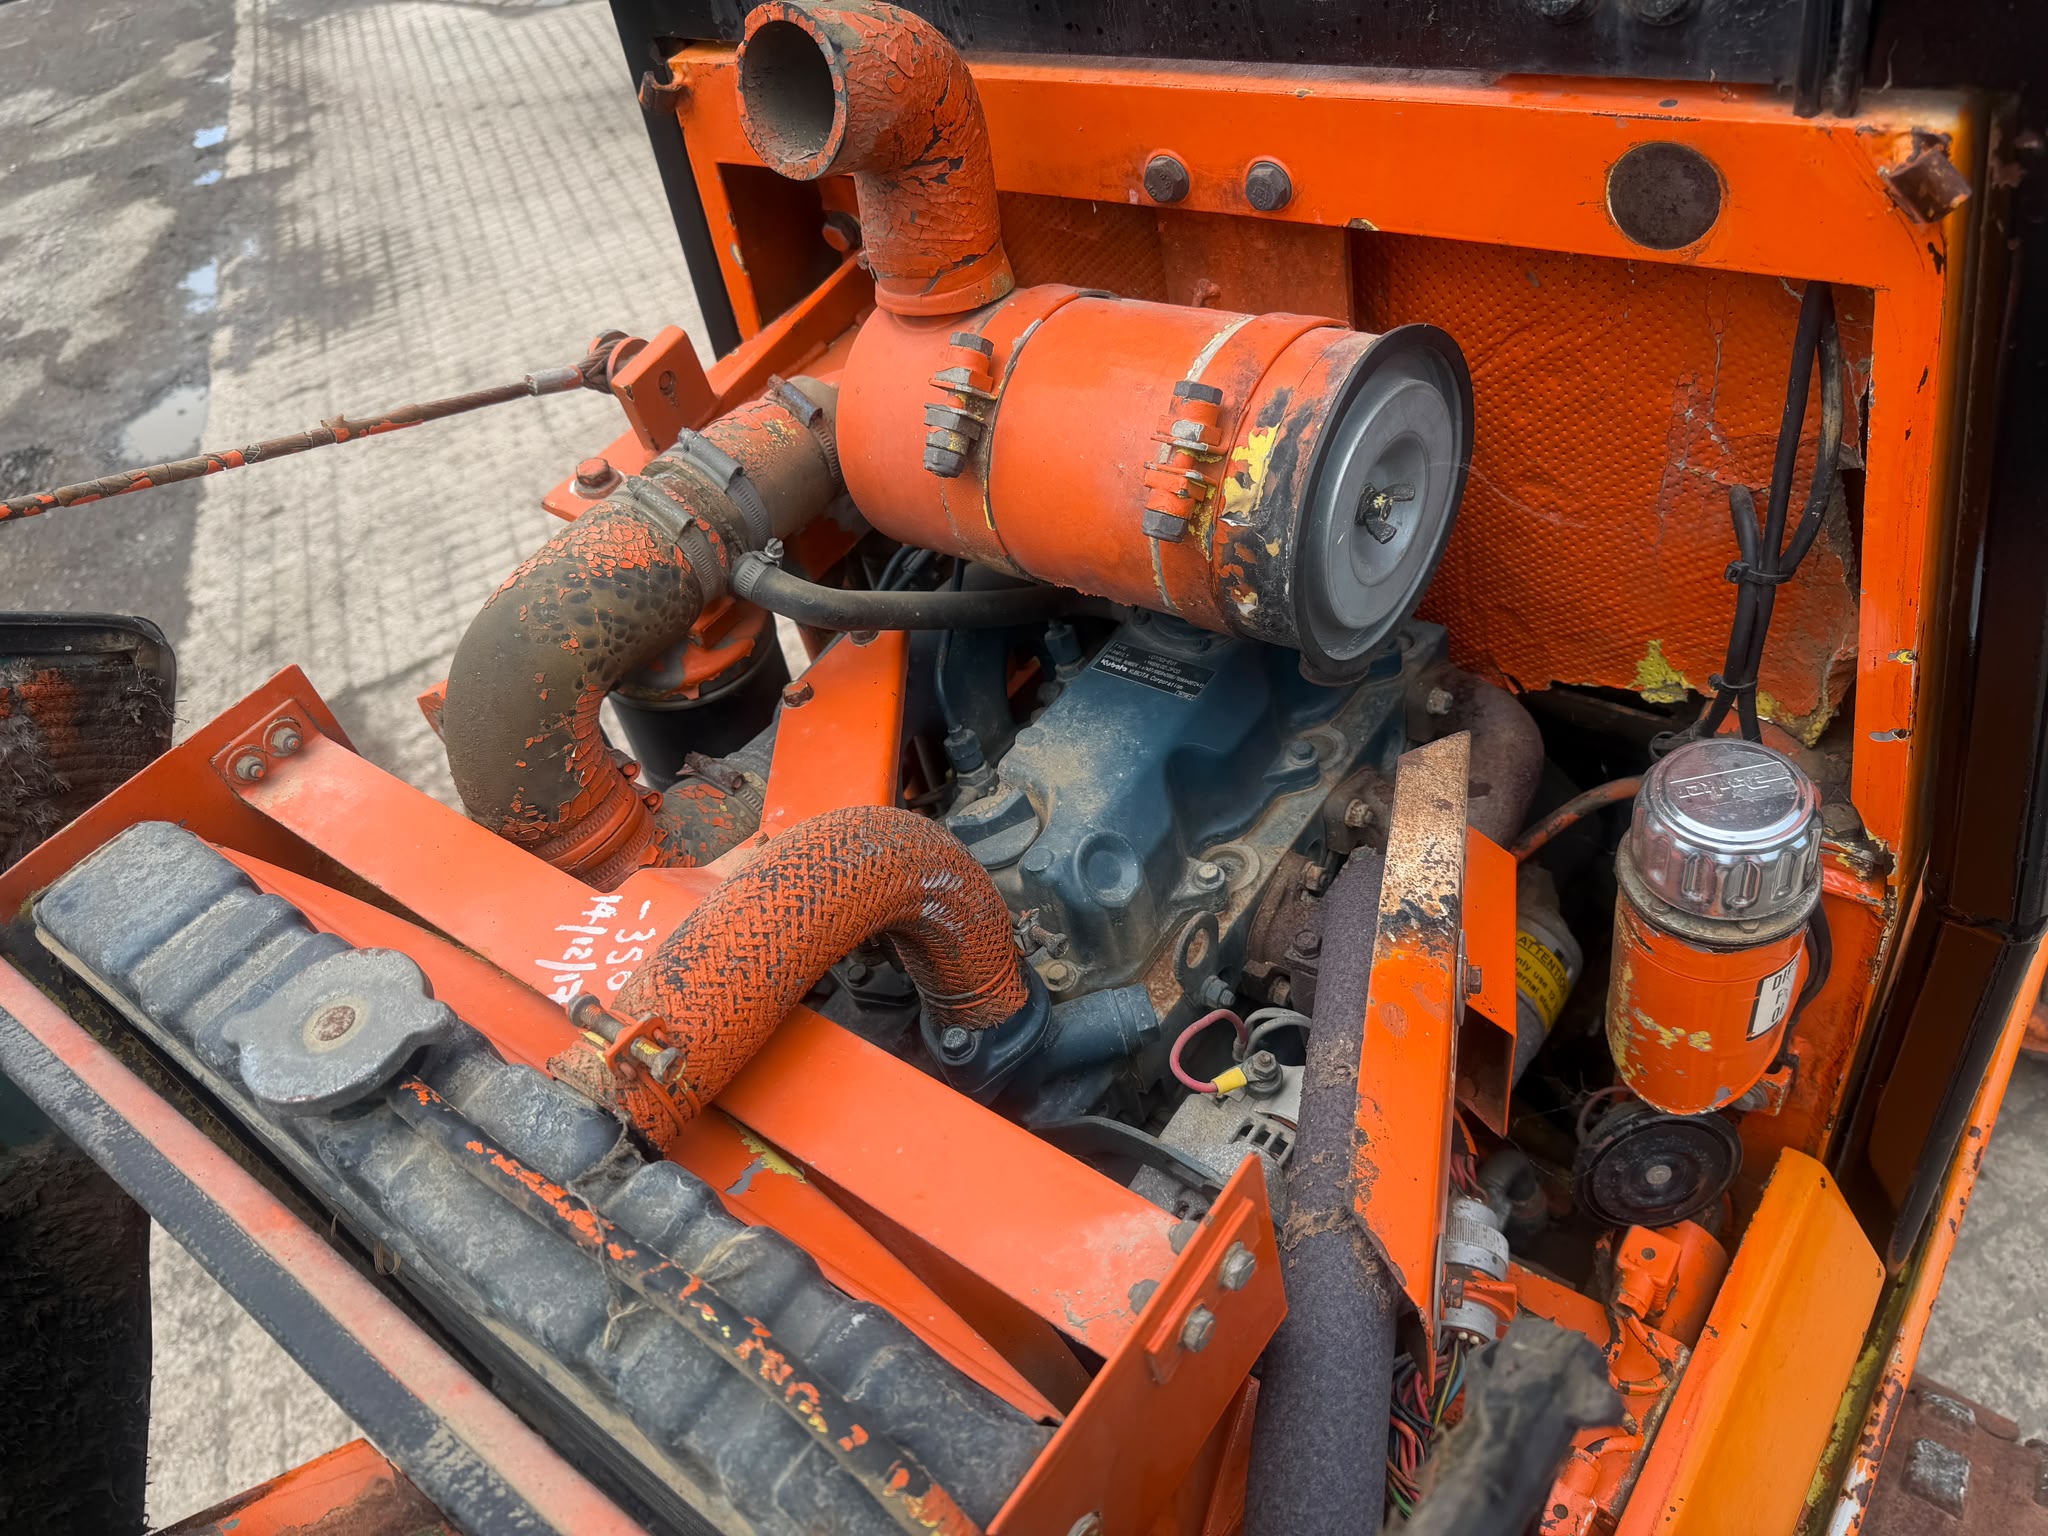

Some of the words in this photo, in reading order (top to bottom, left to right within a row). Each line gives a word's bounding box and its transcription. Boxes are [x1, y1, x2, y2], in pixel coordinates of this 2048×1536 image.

[1100, 658, 1128, 672] Kubota
[1128, 668, 1149, 679] KUBOTA
[1149, 675, 1184, 690] Corporation
[1516, 956, 1532, 971] nly
